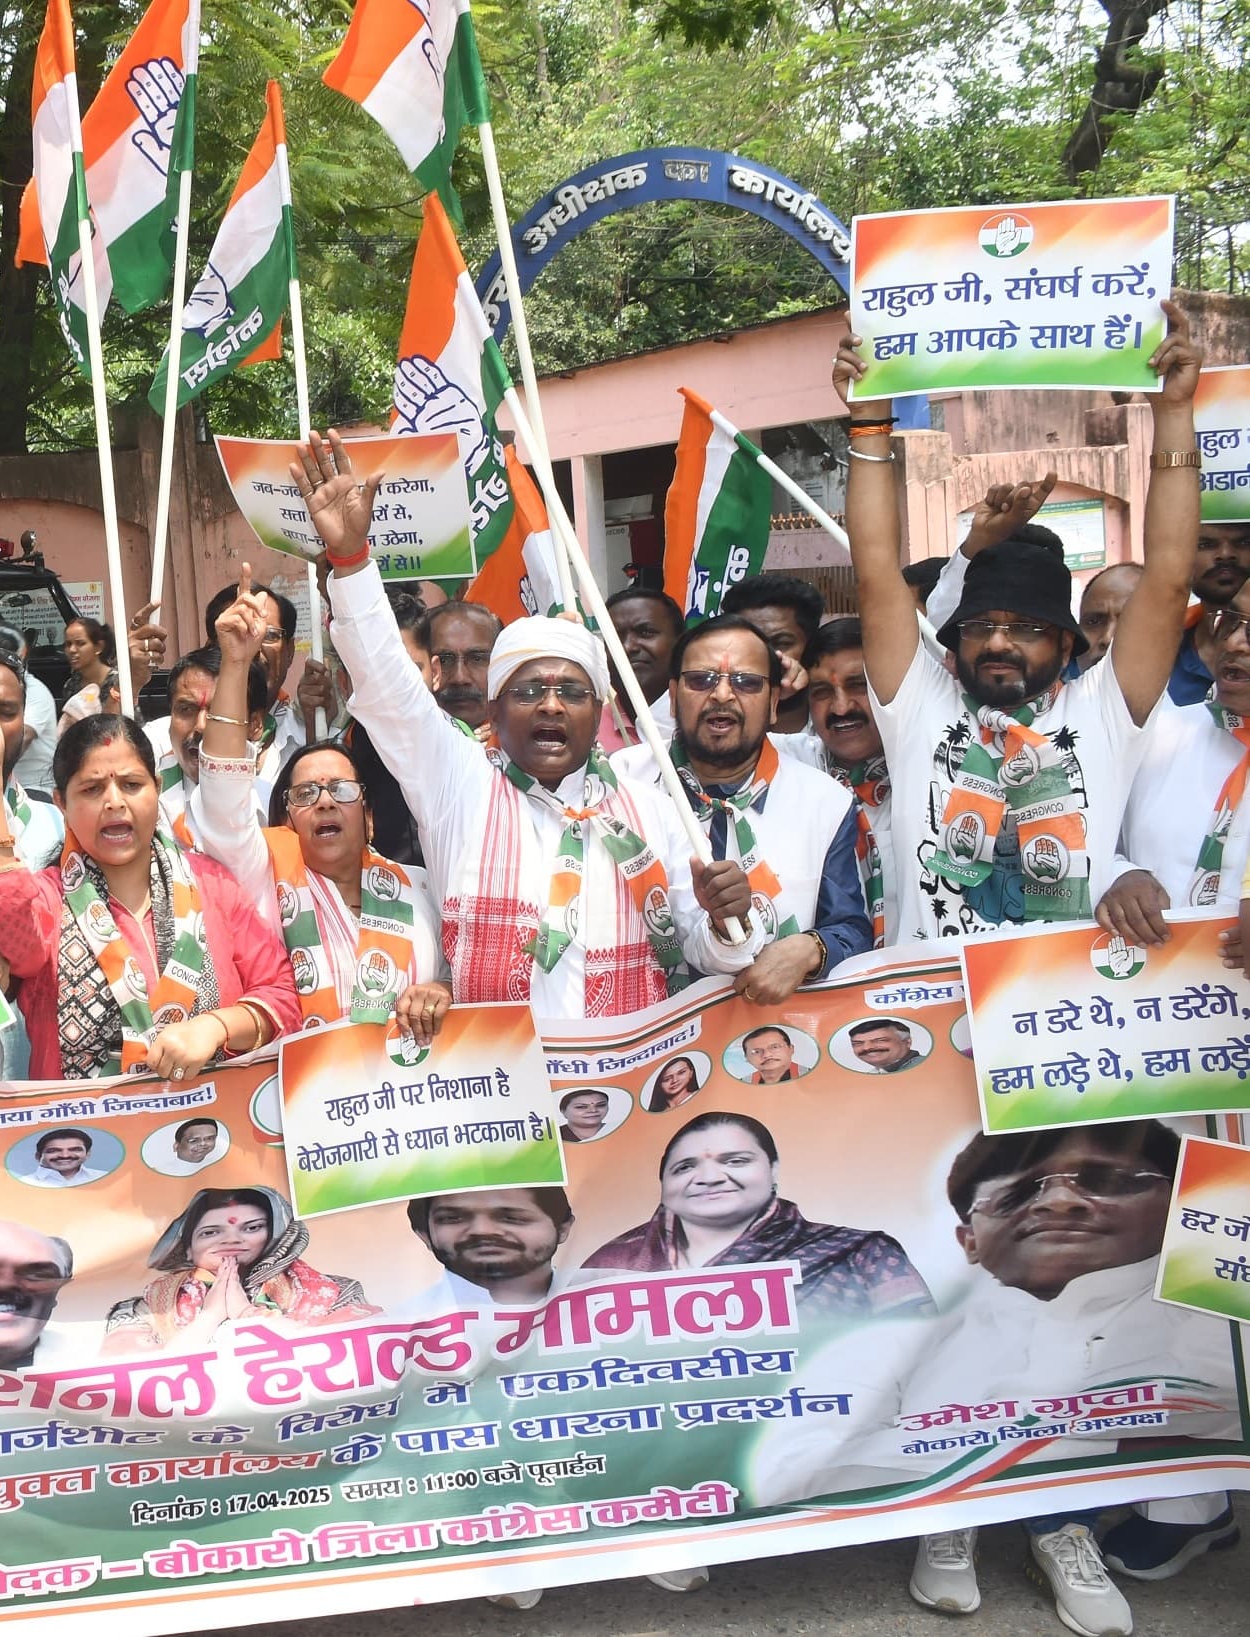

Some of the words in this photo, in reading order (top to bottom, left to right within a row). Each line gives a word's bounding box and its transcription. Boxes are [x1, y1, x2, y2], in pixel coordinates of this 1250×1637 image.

[523, 162, 648, 255] अधीक्षक
[662, 159, 711, 183] का
[862, 282, 938, 317] राहुल
[944, 272, 992, 305] जी,
[1004, 266, 1084, 300] संघर्ष
[1091, 262, 1156, 299] करें,
[873, 332, 918, 360] हम
[926, 320, 1021, 354] आपके
[1030, 324, 1095, 349] साथ
[1104, 314, 1142, 350] हैं।
[1194, 428, 1242, 458] ाहुल
[386, 477, 435, 496] करेगा,
[380, 529, 423, 546] उठेगा,
[1013, 1011, 1038, 1036] न
[1045, 999, 1083, 1034] डरे
[1090, 995, 1126, 1030] थे,
[1134, 996, 1162, 1022] न
[547, 1058, 588, 1076] ाँधी
[989, 1065, 1034, 1095] हम
[1041, 1052, 1090, 1093] लड़े
[1098, 1047, 1134, 1083] थे,
[1142, 1048, 1191, 1077] हम
[325, 1093, 369, 1126] राहुल
[373, 1081, 396, 1114] जी
[399, 1082, 425, 1106] पर
[428, 1073, 492, 1103] निशाना
[495, 1067, 511, 1098] है
[297, 1130, 378, 1172] बेरोजगारी
[382, 1127, 400, 1156] से
[404, 1125, 449, 1150] ध्यान
[454, 1118, 526, 1146] भटकाना
[529, 1111, 553, 1141] है।
[1181, 1207, 1220, 1234] हर
[232, 1309, 479, 1406] हेराल्ड
[495, 1268, 796, 1354] मामला
[191, 1425, 252, 1445] के
[277, 1393, 400, 1441] विरोध
[500, 1347, 797, 1400] एकदिवसीय
[900, 1400, 1019, 1433] उमेश
[1032, 1384, 1158, 1420] गुप्ता
[109, 1449, 323, 1486] कार्यालय
[333, 1433, 384, 1465] के
[396, 1421, 499, 1455] पास
[513, 1403, 662, 1444] धारना
[675, 1388, 853, 1430] प्रदर्शन
[902, 1430, 991, 1455] बोकारो
[997, 1423, 1067, 1442] जिला
[1076, 1412, 1164, 1434] अध्यक्ष
[132, 1498, 206, 1525] दिनांक
[227, 1486, 330, 1513] 17.04.2025
[343, 1480, 400, 1500] समय
[425, 1471, 477, 1492] 11:00
[483, 1462, 521, 1484] बजे
[154, 1532, 305, 1576] बोकारो
[316, 1520, 433, 1559] जिला
[443, 1501, 584, 1543] कांग्रेस
[593, 1484, 735, 1525] कमेटी
